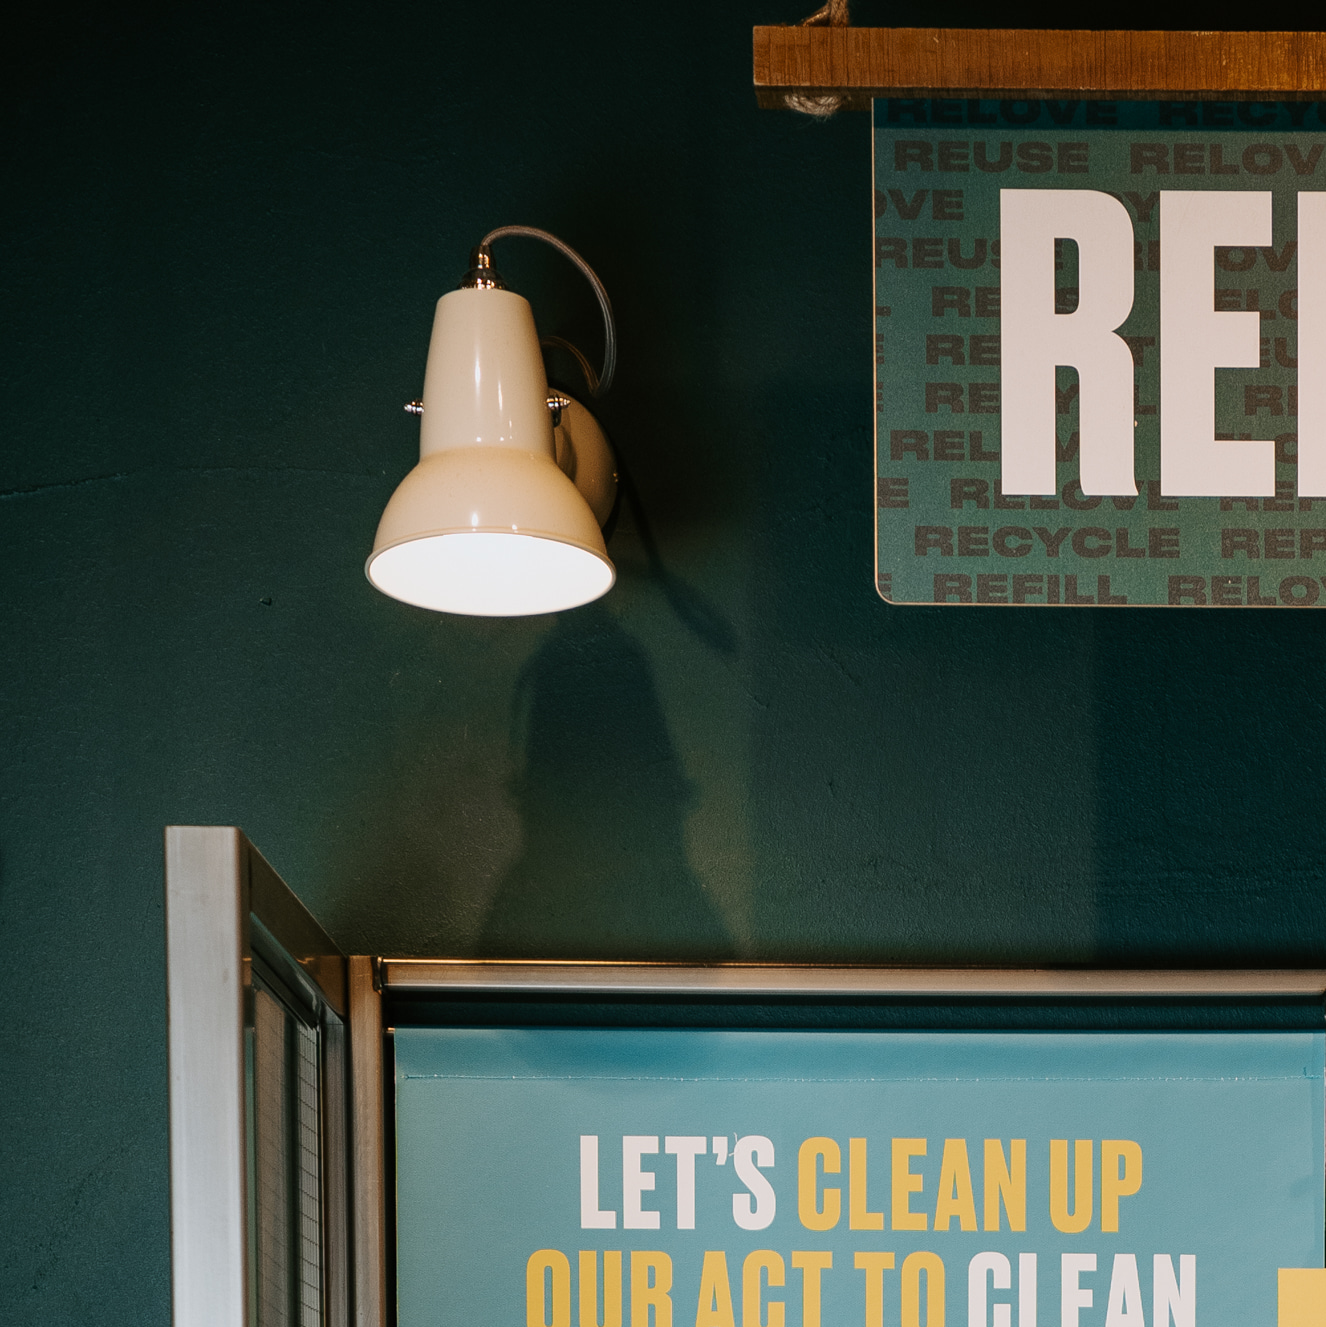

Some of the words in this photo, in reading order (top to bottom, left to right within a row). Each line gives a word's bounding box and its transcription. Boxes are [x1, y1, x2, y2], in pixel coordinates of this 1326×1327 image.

[894, 140, 1090, 173] REUSE
[914, 526, 1181, 558] RECYCLE
[580, 1133, 777, 1231] LET'S
[797, 1136, 1027, 1232] CLEAN
[1049, 1139, 1143, 1234] UP
